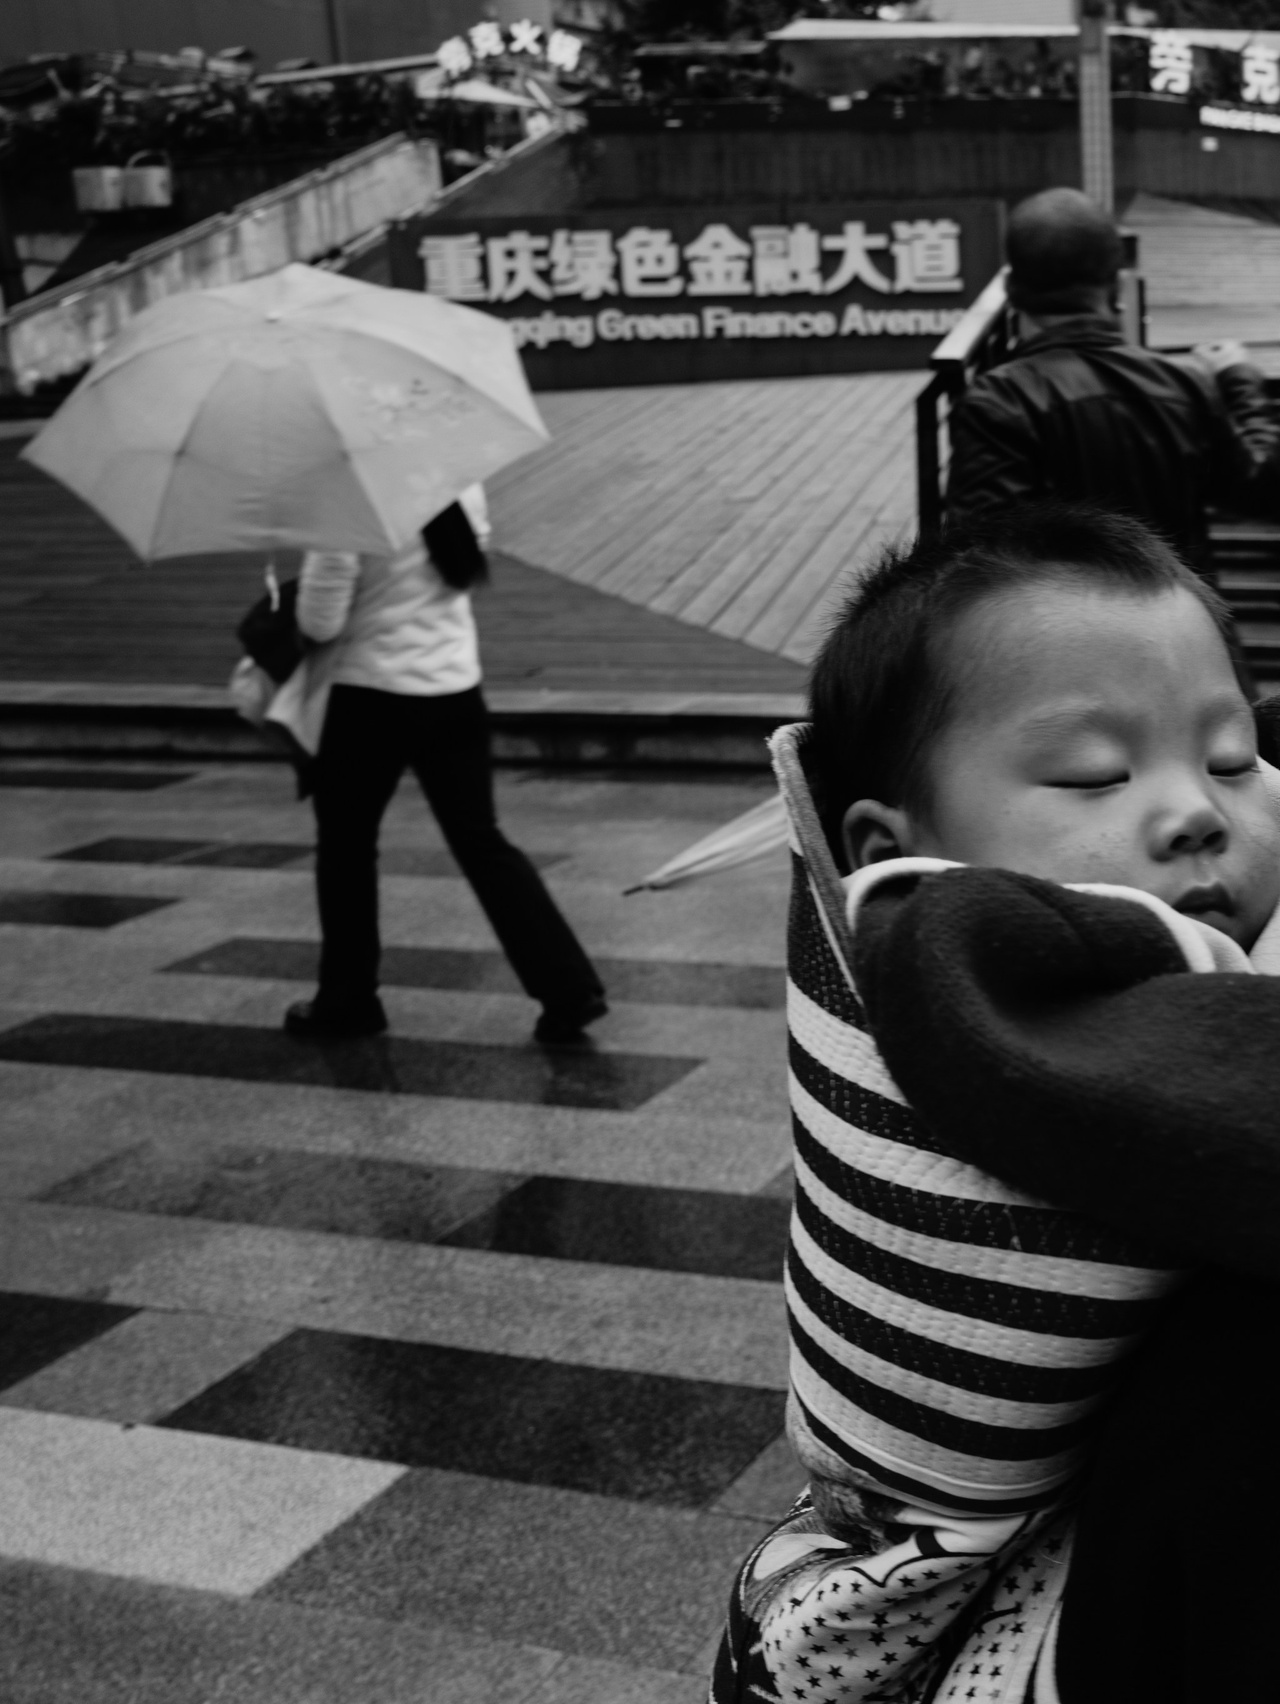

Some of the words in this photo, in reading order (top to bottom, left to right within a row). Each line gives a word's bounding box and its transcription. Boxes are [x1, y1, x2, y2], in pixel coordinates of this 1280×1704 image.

[418, 219, 964, 301] 重庆绿色金融大道
[597, 308, 699, 341] Green
[702, 305, 837, 340] Finance
